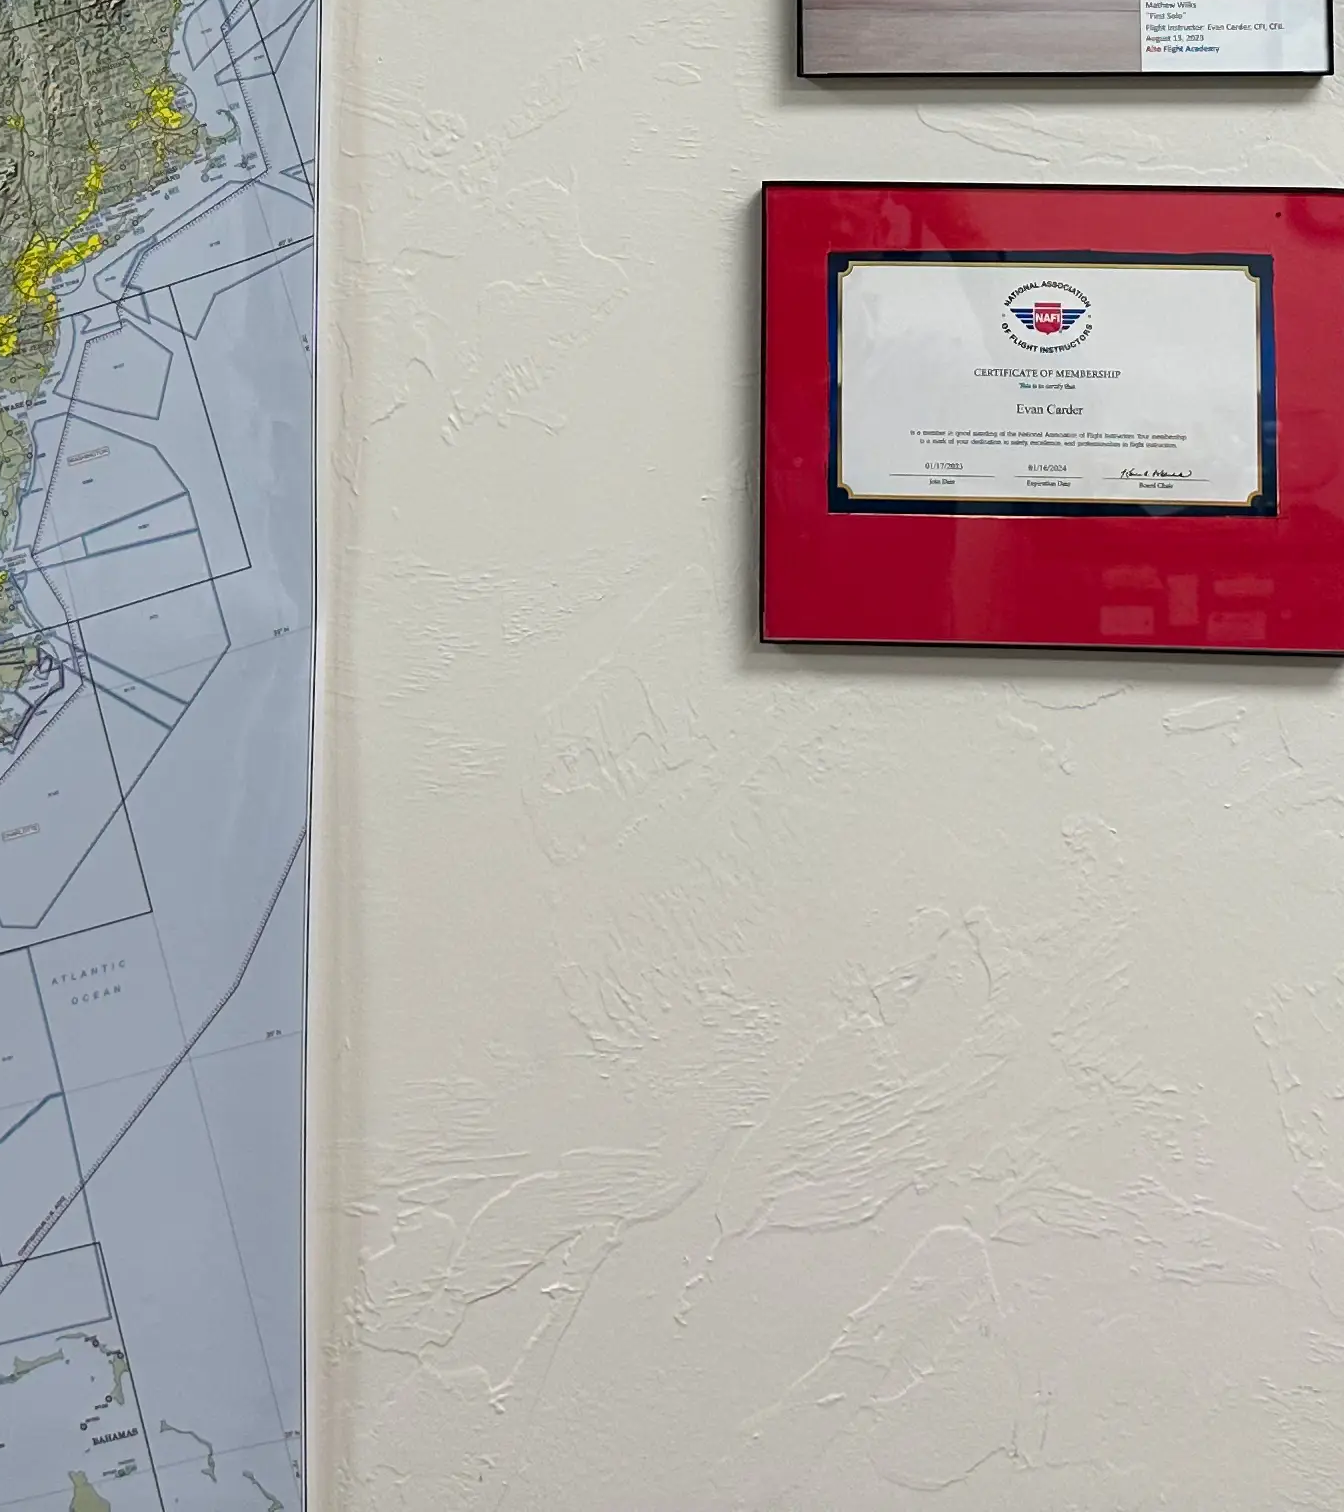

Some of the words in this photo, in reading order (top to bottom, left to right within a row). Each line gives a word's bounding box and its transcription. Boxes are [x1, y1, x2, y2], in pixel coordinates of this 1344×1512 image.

[1004, 281, 1040, 306] NATIONAL
[1040, 281, 1091, 308] ASSOCIATION
[1009, 334, 1038, 352] FLIGHT
[1040, 324, 1092, 353] INSTRUCTORS
[974, 368, 1038, 377] CERTIFICATE
[1056, 370, 1121, 378] MEMBERSHIP
[1017, 404, 1043, 414] Evan
[1047, 404, 1083, 415] Carder
[51, 960, 126, 985] ATLANTIC
[71, 985, 121, 1005] OCEAN
[92, 1428, 138, 1446] BAHAMAS
